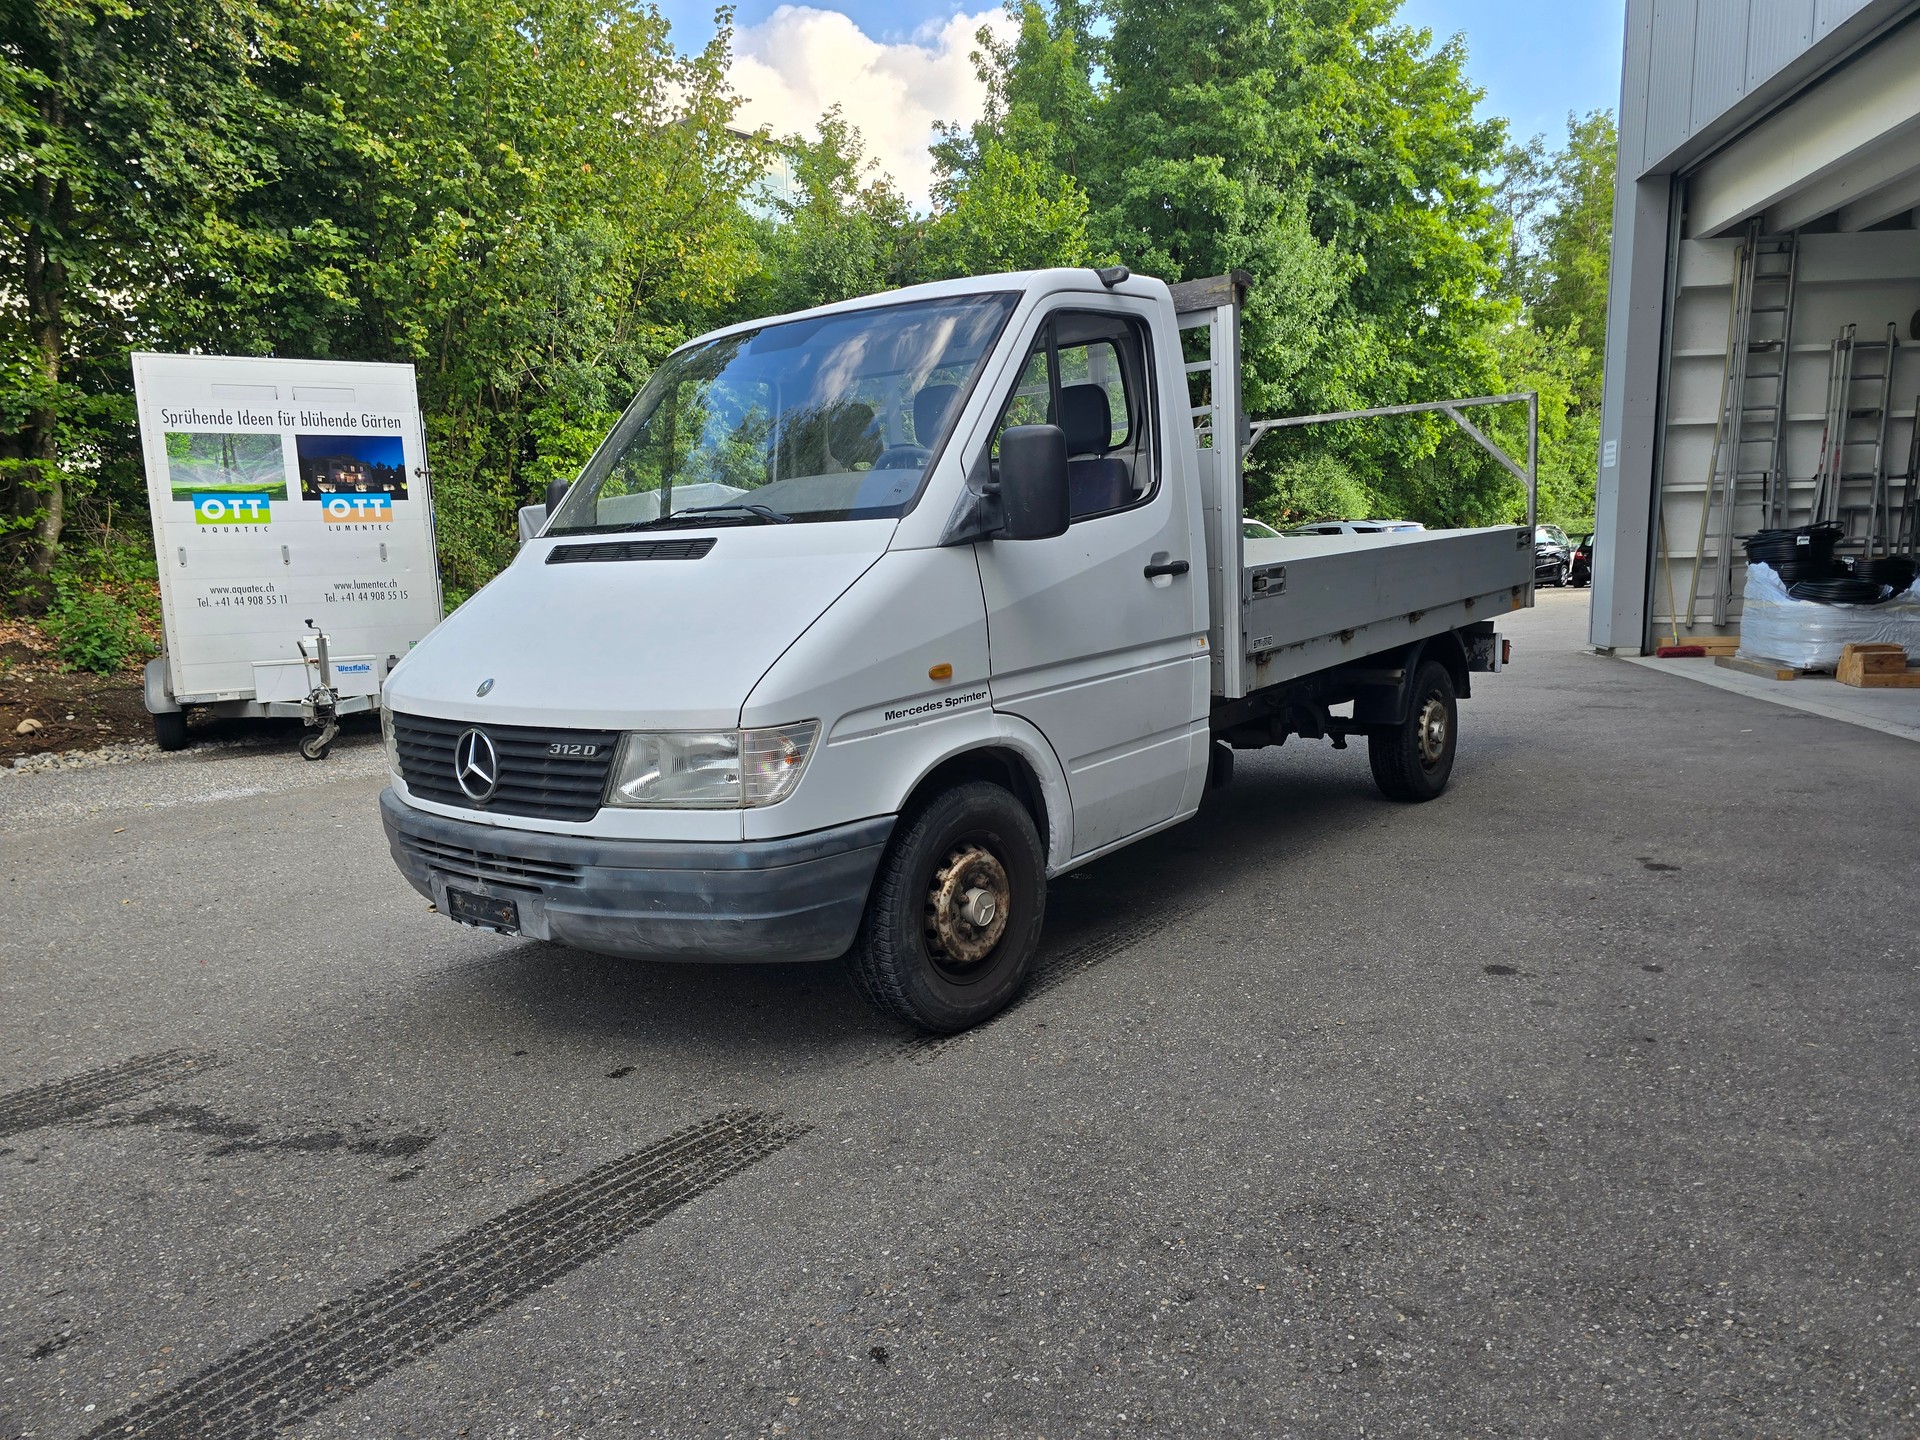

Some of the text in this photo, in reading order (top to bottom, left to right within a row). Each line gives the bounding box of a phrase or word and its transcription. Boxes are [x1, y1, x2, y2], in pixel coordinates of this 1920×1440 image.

[161, 408, 401, 429] Sprühende Ideen für blühende Gärten
[201, 499, 262, 520] OTT
[328, 498, 385, 518] OTT
[209, 582, 275, 595] www.aquatec.ch
[333, 578, 398, 590] www.lumentec.ch
[197, 594, 288, 607] Tel. +41 44 908 55 11
[324, 590, 408, 602] Tel. +41 44 908 55 15
[884, 691, 987, 721] Mercedes Sprinter
